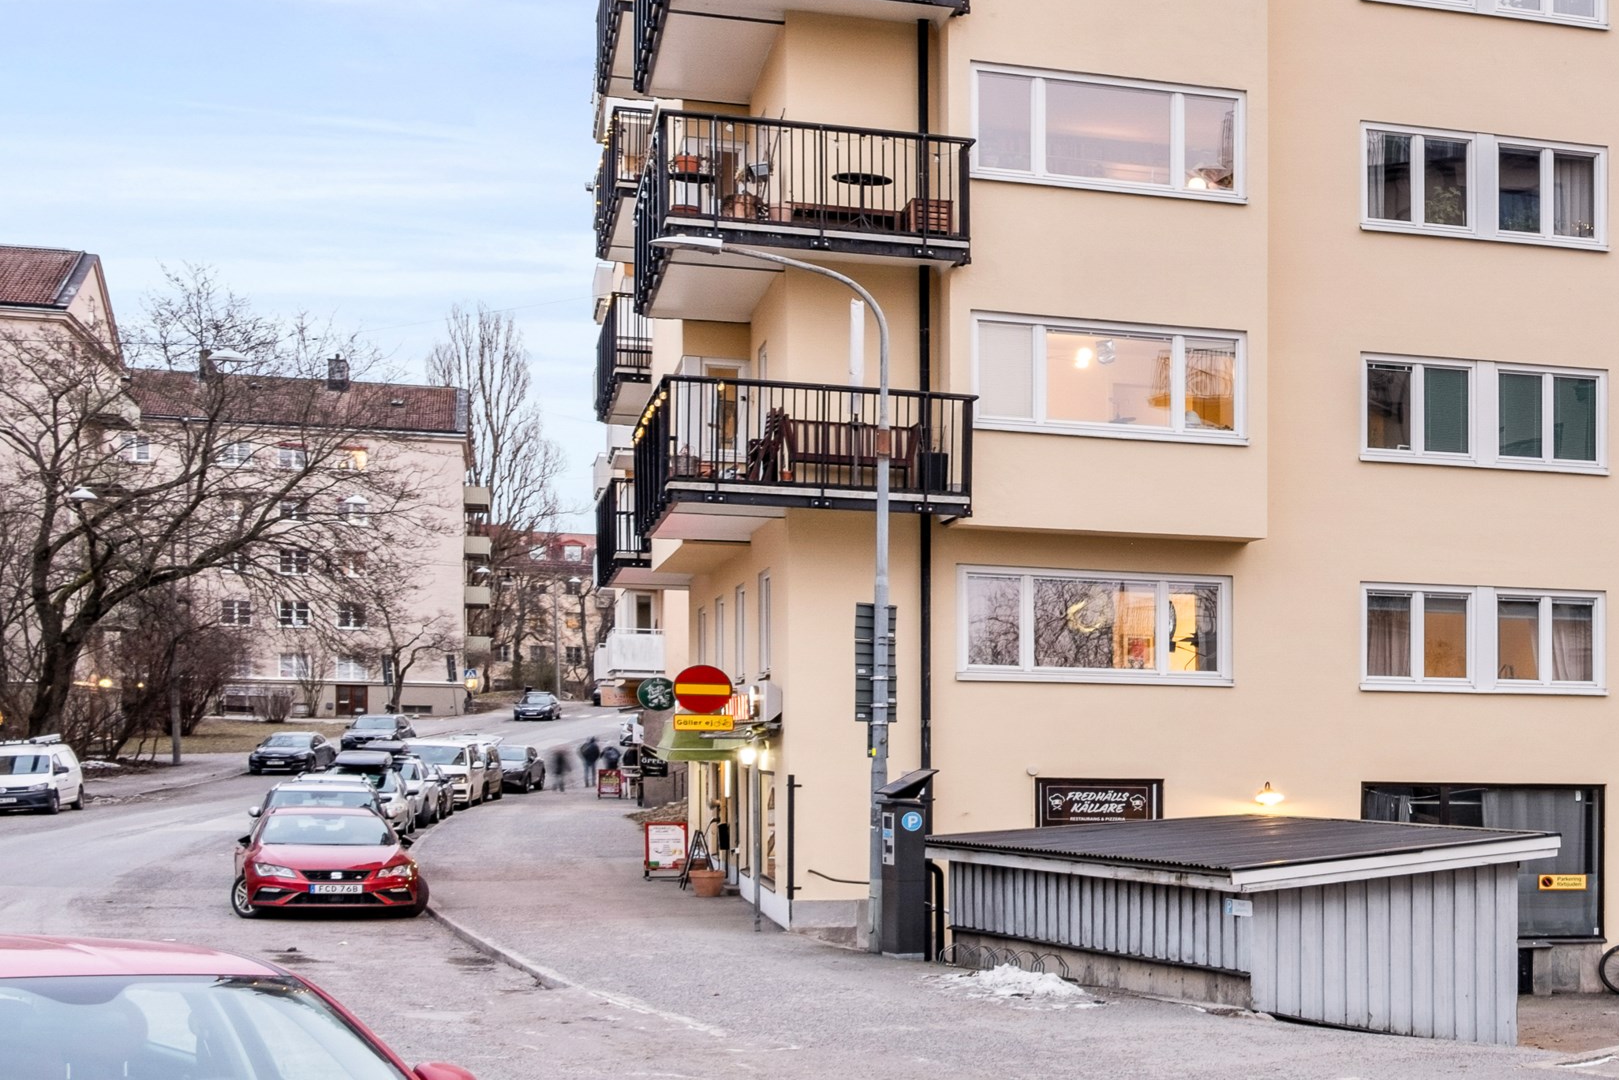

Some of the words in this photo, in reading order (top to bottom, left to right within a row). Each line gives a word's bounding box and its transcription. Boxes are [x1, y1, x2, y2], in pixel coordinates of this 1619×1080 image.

[1066, 790, 1130, 802] FREDHÄLLS
[1070, 801, 1126, 813] KÄLLARE
[907, 815, 919, 828] P
[318, 885, 338, 893] FCD
